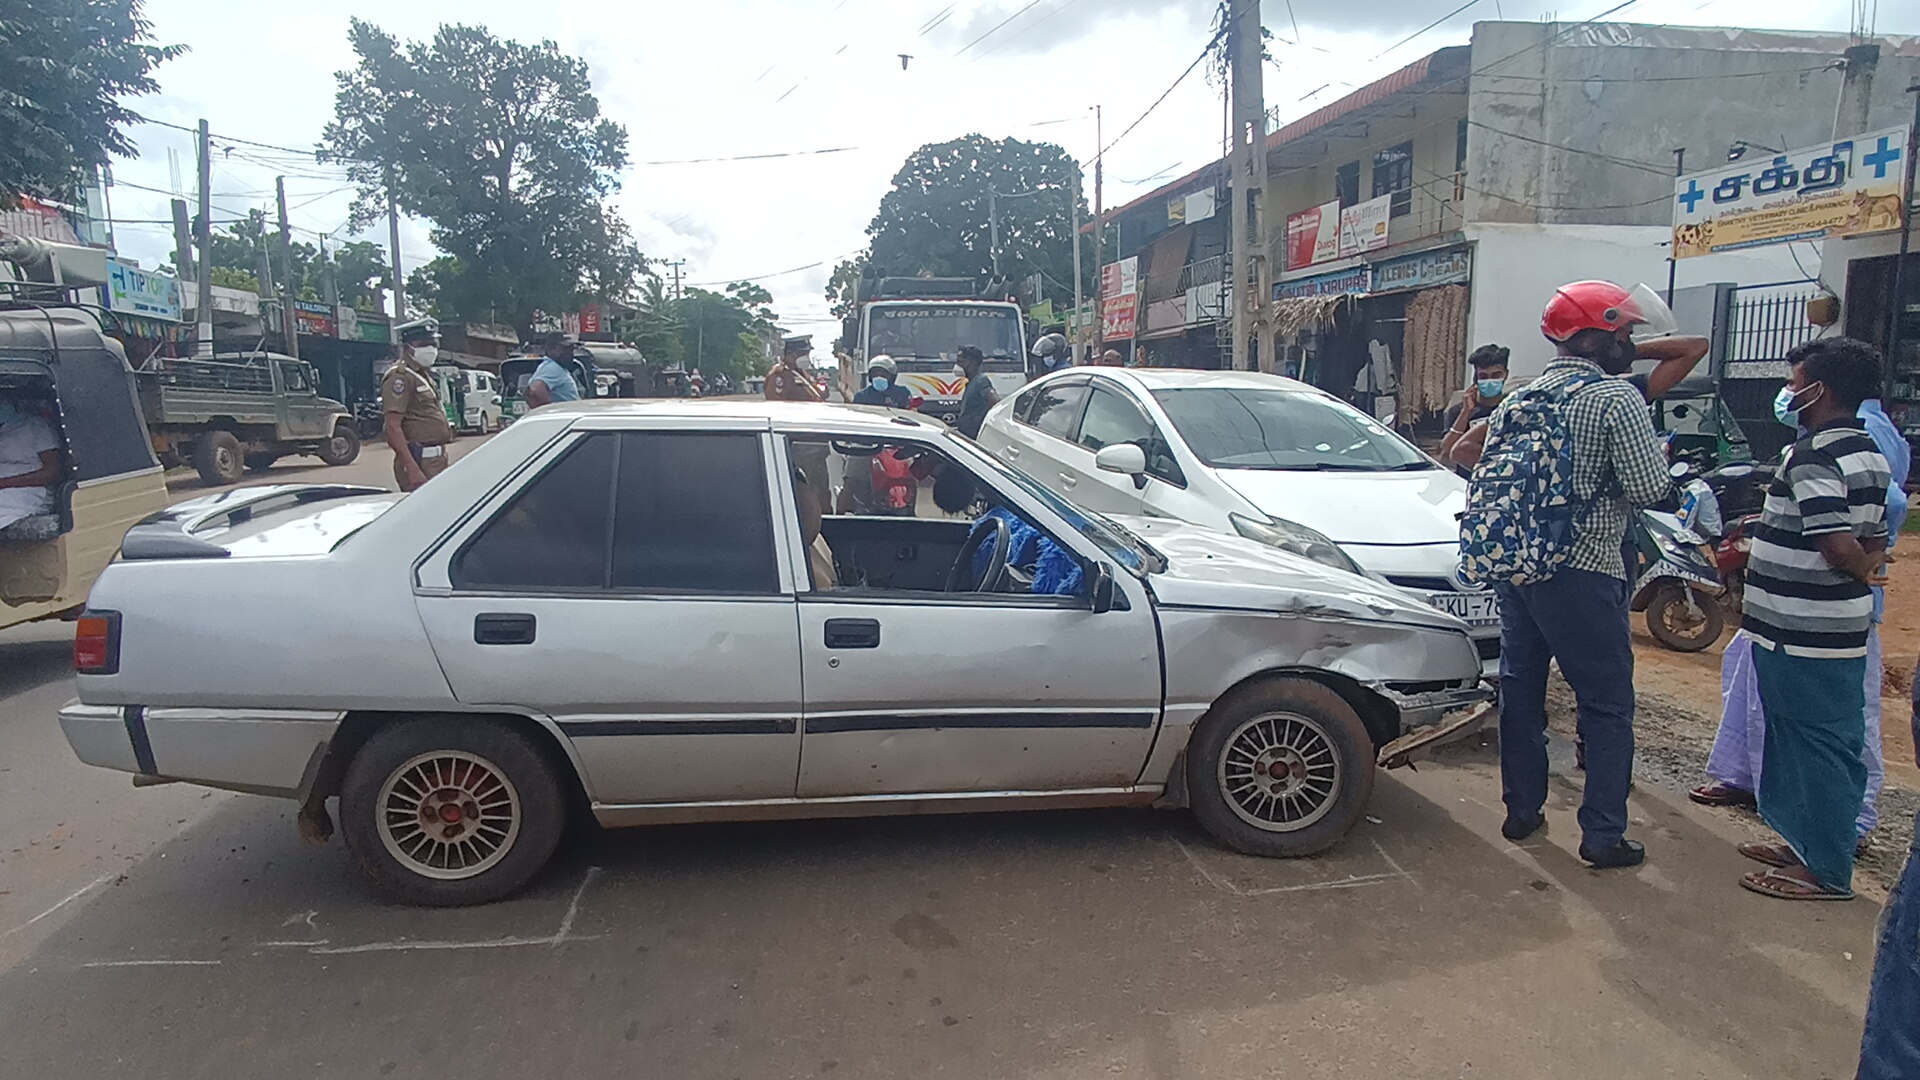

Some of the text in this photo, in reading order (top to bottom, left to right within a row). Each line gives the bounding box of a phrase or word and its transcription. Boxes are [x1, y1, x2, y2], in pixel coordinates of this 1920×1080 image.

[1713, 140, 1854, 204] சக்தி
[1749, 210, 1787, 222] VETERINARY
[883, 307, 1006, 318] Moon Drillers
